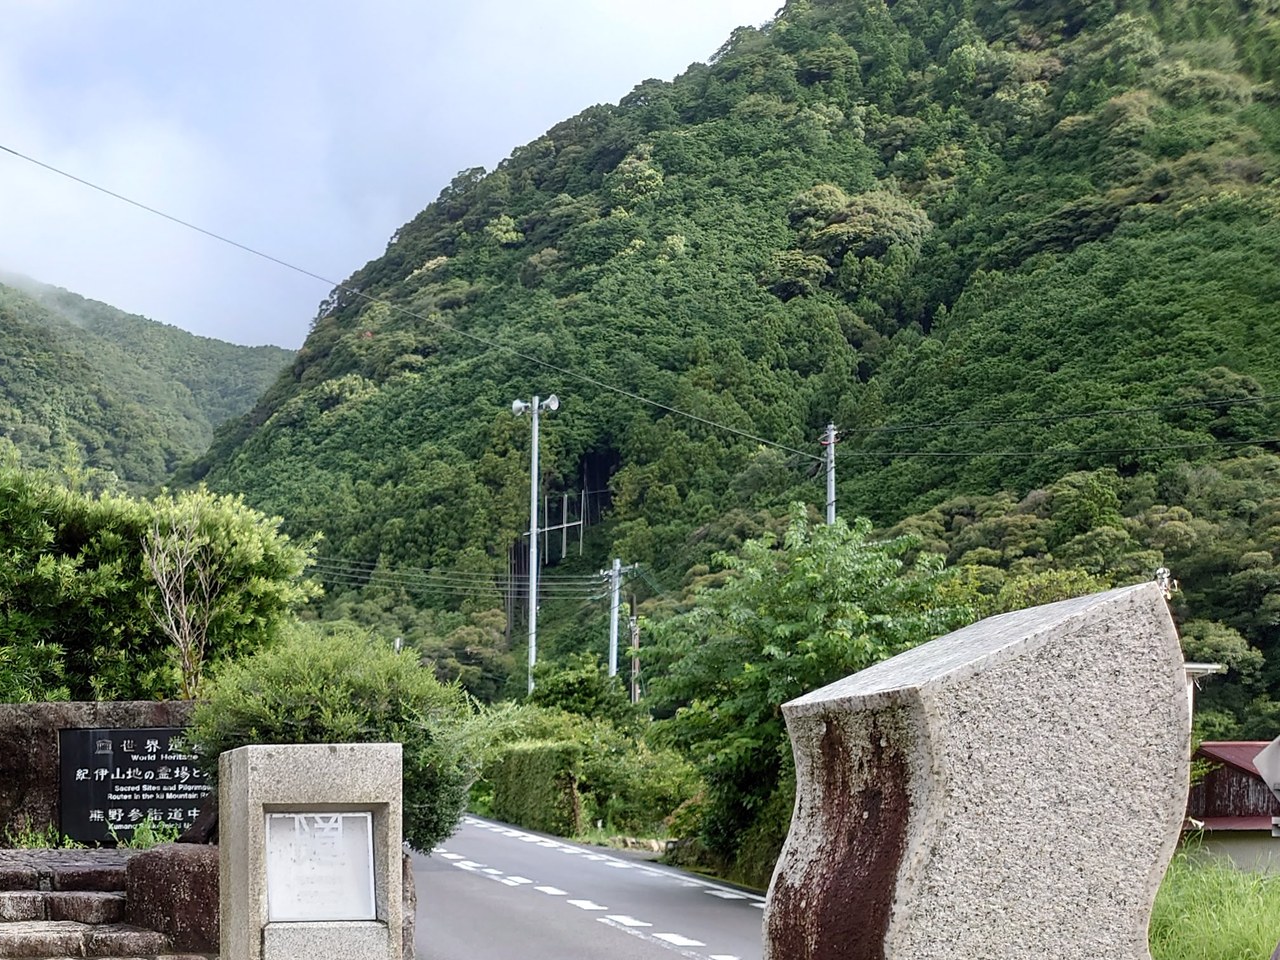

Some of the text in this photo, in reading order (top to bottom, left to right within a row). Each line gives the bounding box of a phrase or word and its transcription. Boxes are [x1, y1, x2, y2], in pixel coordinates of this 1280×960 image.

[76, 766, 209, 783] 紀伊山地の霊場と
[166, 791, 198, 799] Mountain
